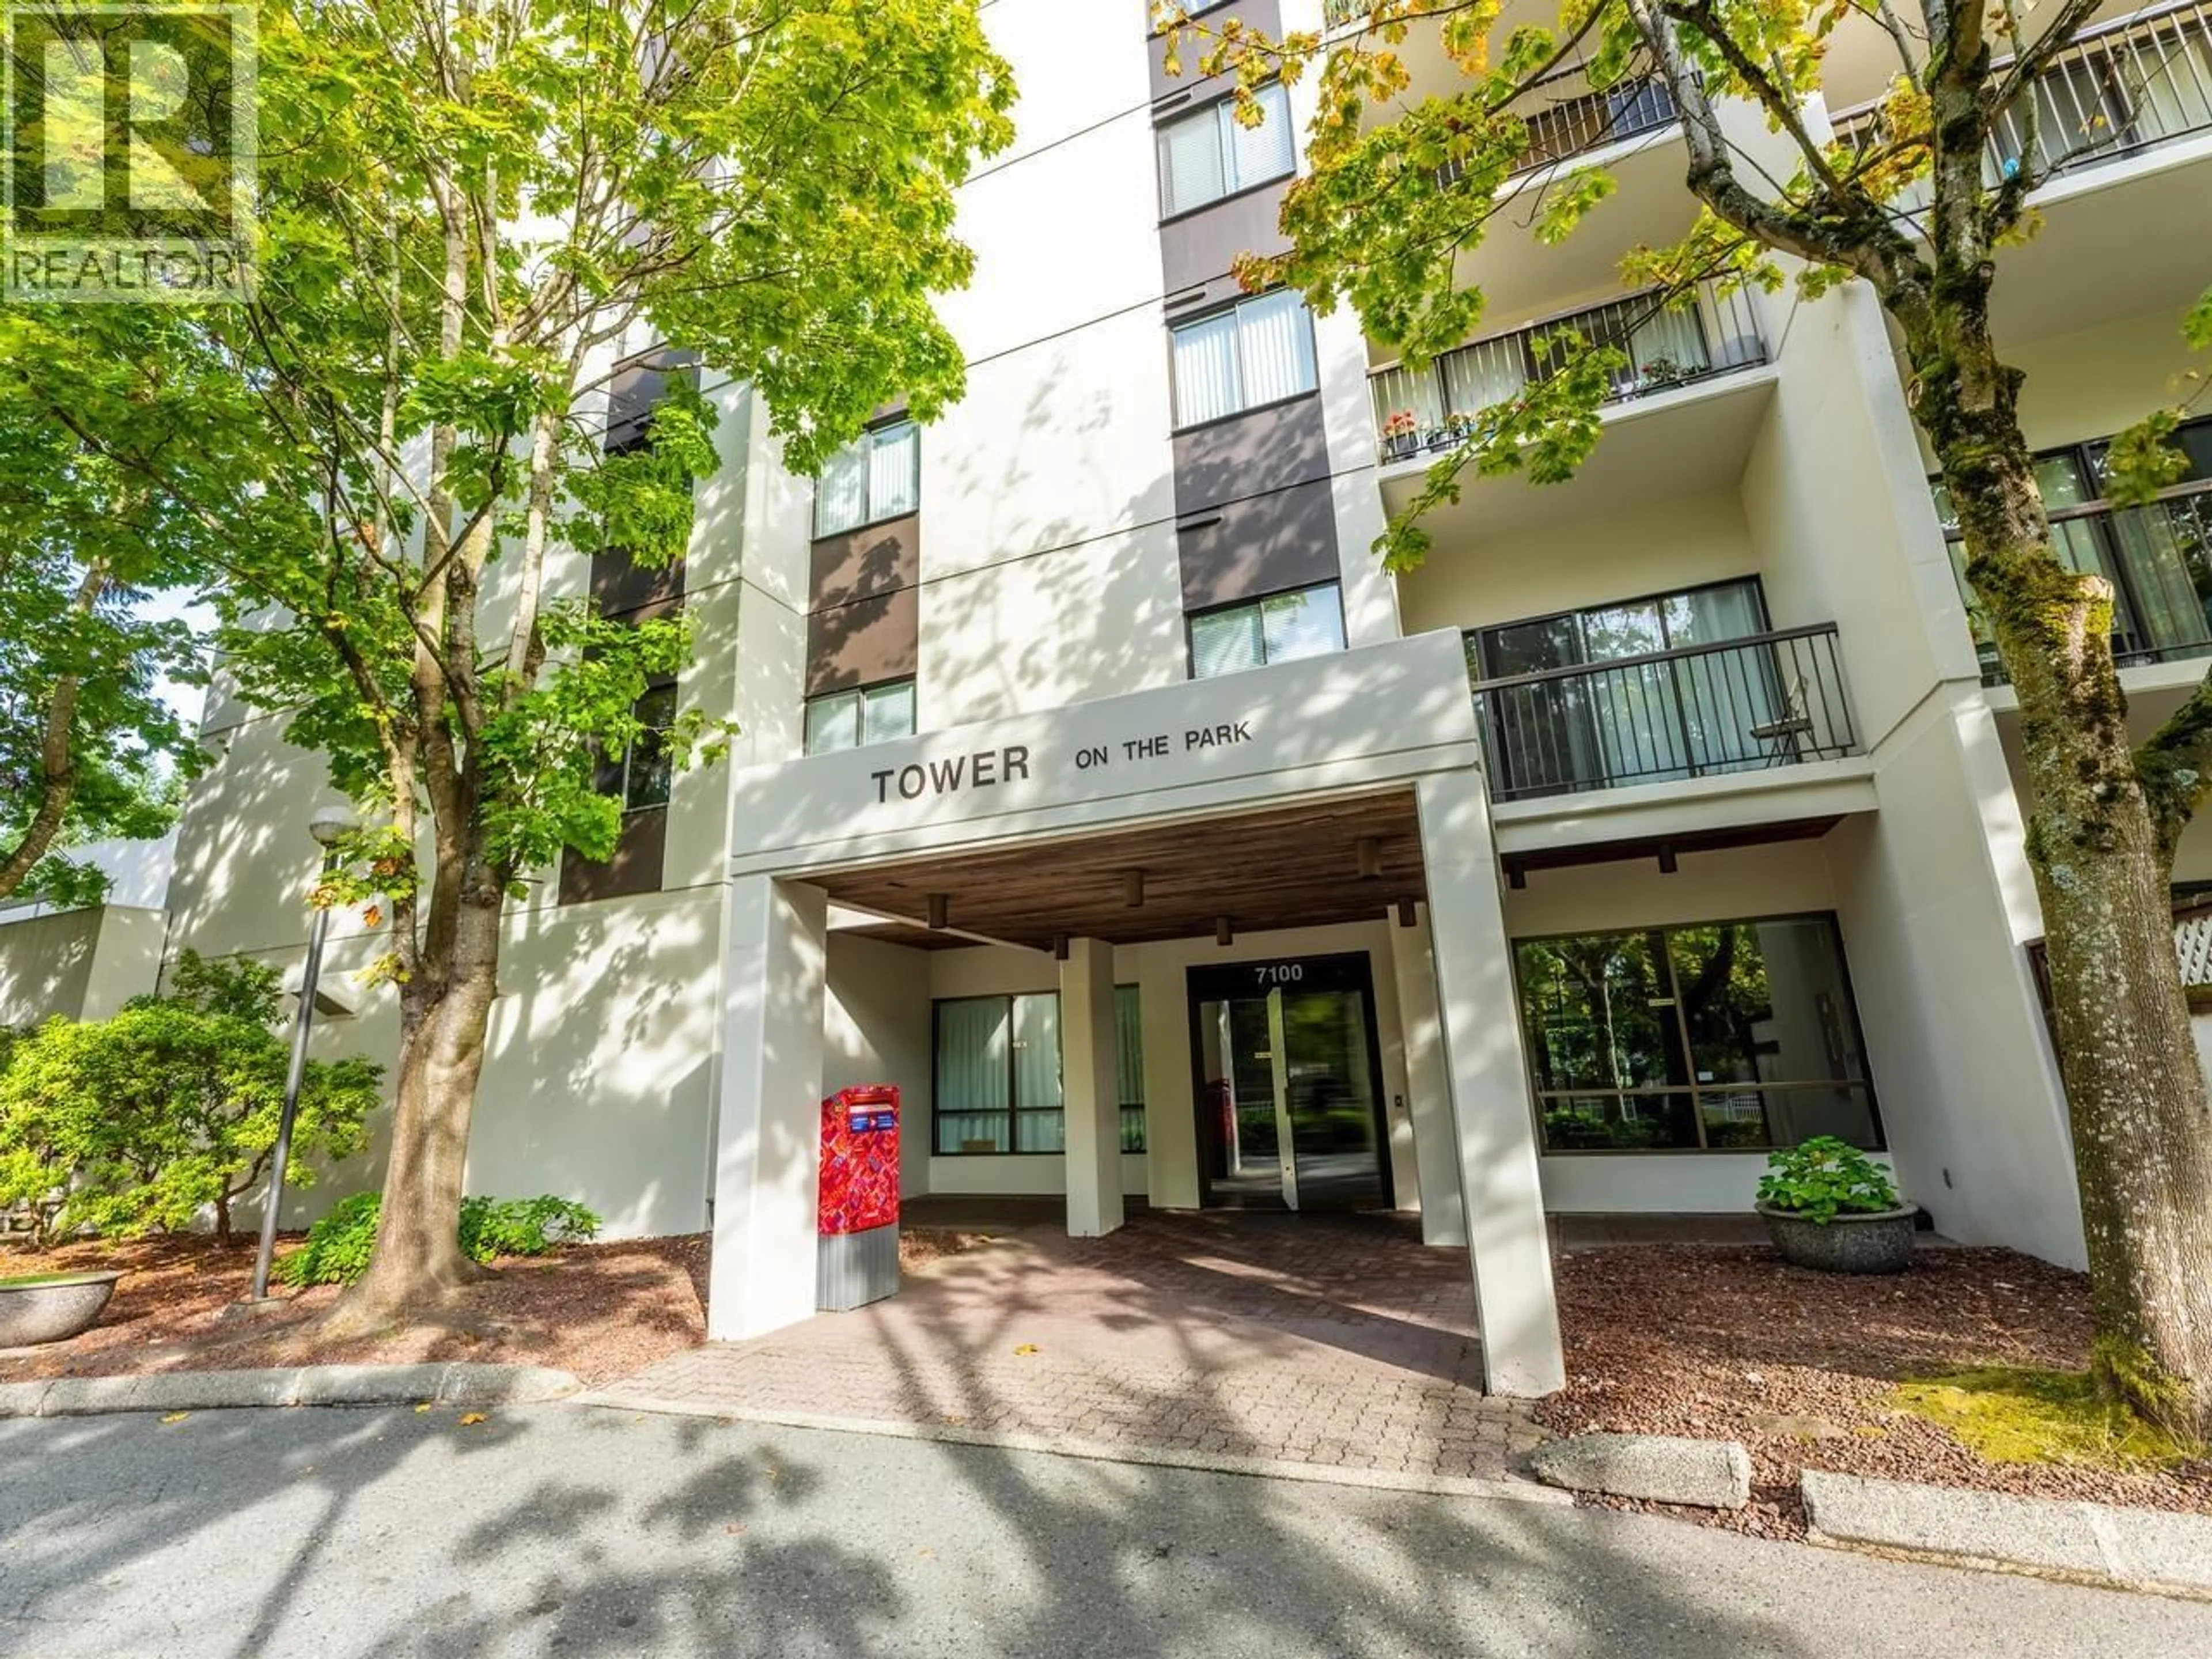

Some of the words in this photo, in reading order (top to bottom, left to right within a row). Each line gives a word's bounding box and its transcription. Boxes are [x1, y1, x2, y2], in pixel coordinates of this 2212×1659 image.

[871, 746, 1029, 803] TOWER
[1075, 747, 1108, 769] ON
[1123, 735, 1170, 761] THE
[1185, 721, 1252, 751] PARK
[1255, 964, 1302, 984] 7100
